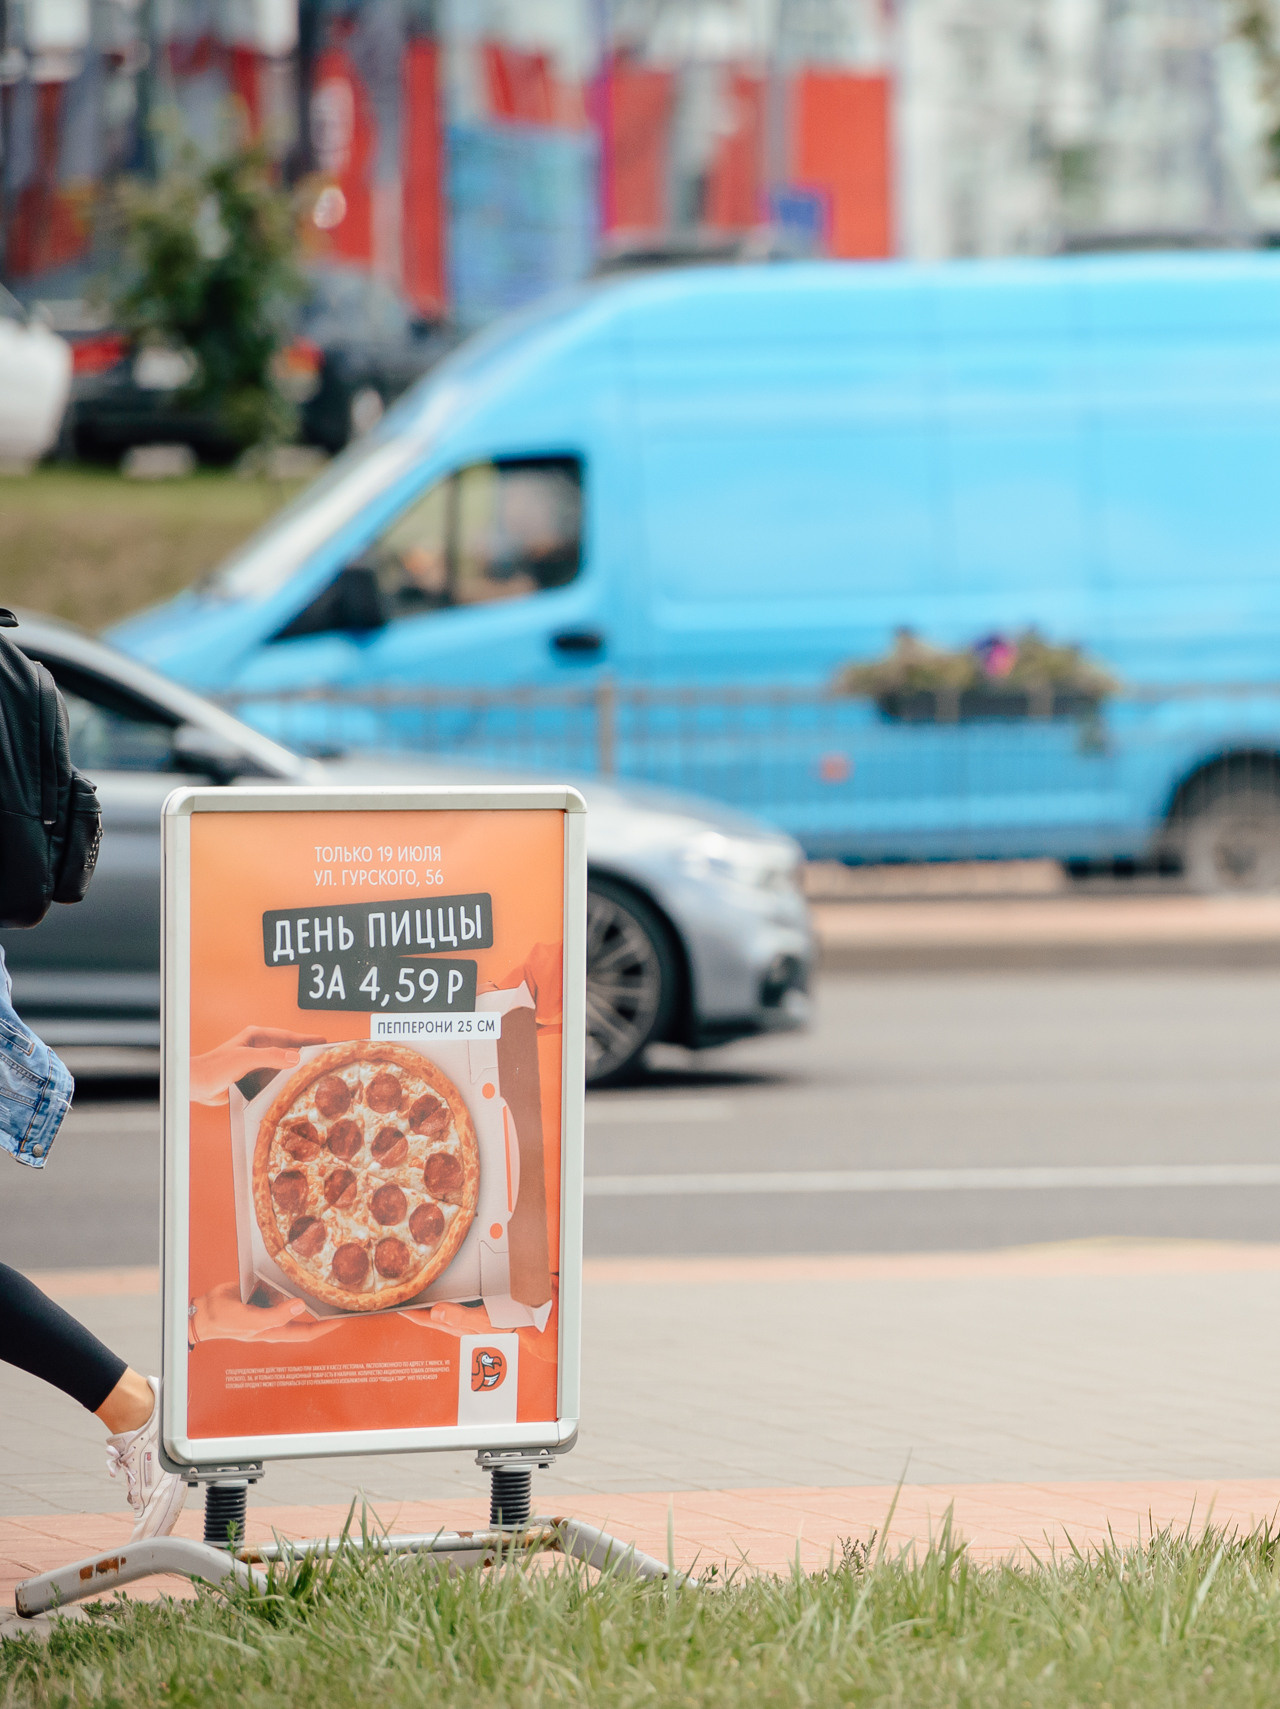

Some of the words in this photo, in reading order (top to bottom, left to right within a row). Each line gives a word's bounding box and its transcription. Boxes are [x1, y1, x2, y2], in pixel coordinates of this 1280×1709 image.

[314, 846, 373, 863] ТОЛЬКО
[377, 846, 393, 863] 19
[398, 845, 441, 862] ИЮЛЯ
[313, 869, 337, 887] УЛ.
[342, 868, 421, 888] ГУРСКОГО,
[425, 868, 444, 886] 56
[272, 915, 355, 963] ДЕНЬ
[368, 904, 482, 950] ПИЦЦЫ
[308, 963, 346, 1000] ЗА
[377, 1020, 453, 1035] ПЕППЕРОНИ
[457, 1019, 473, 1033] 25
[477, 1019, 495, 1032] СМ
